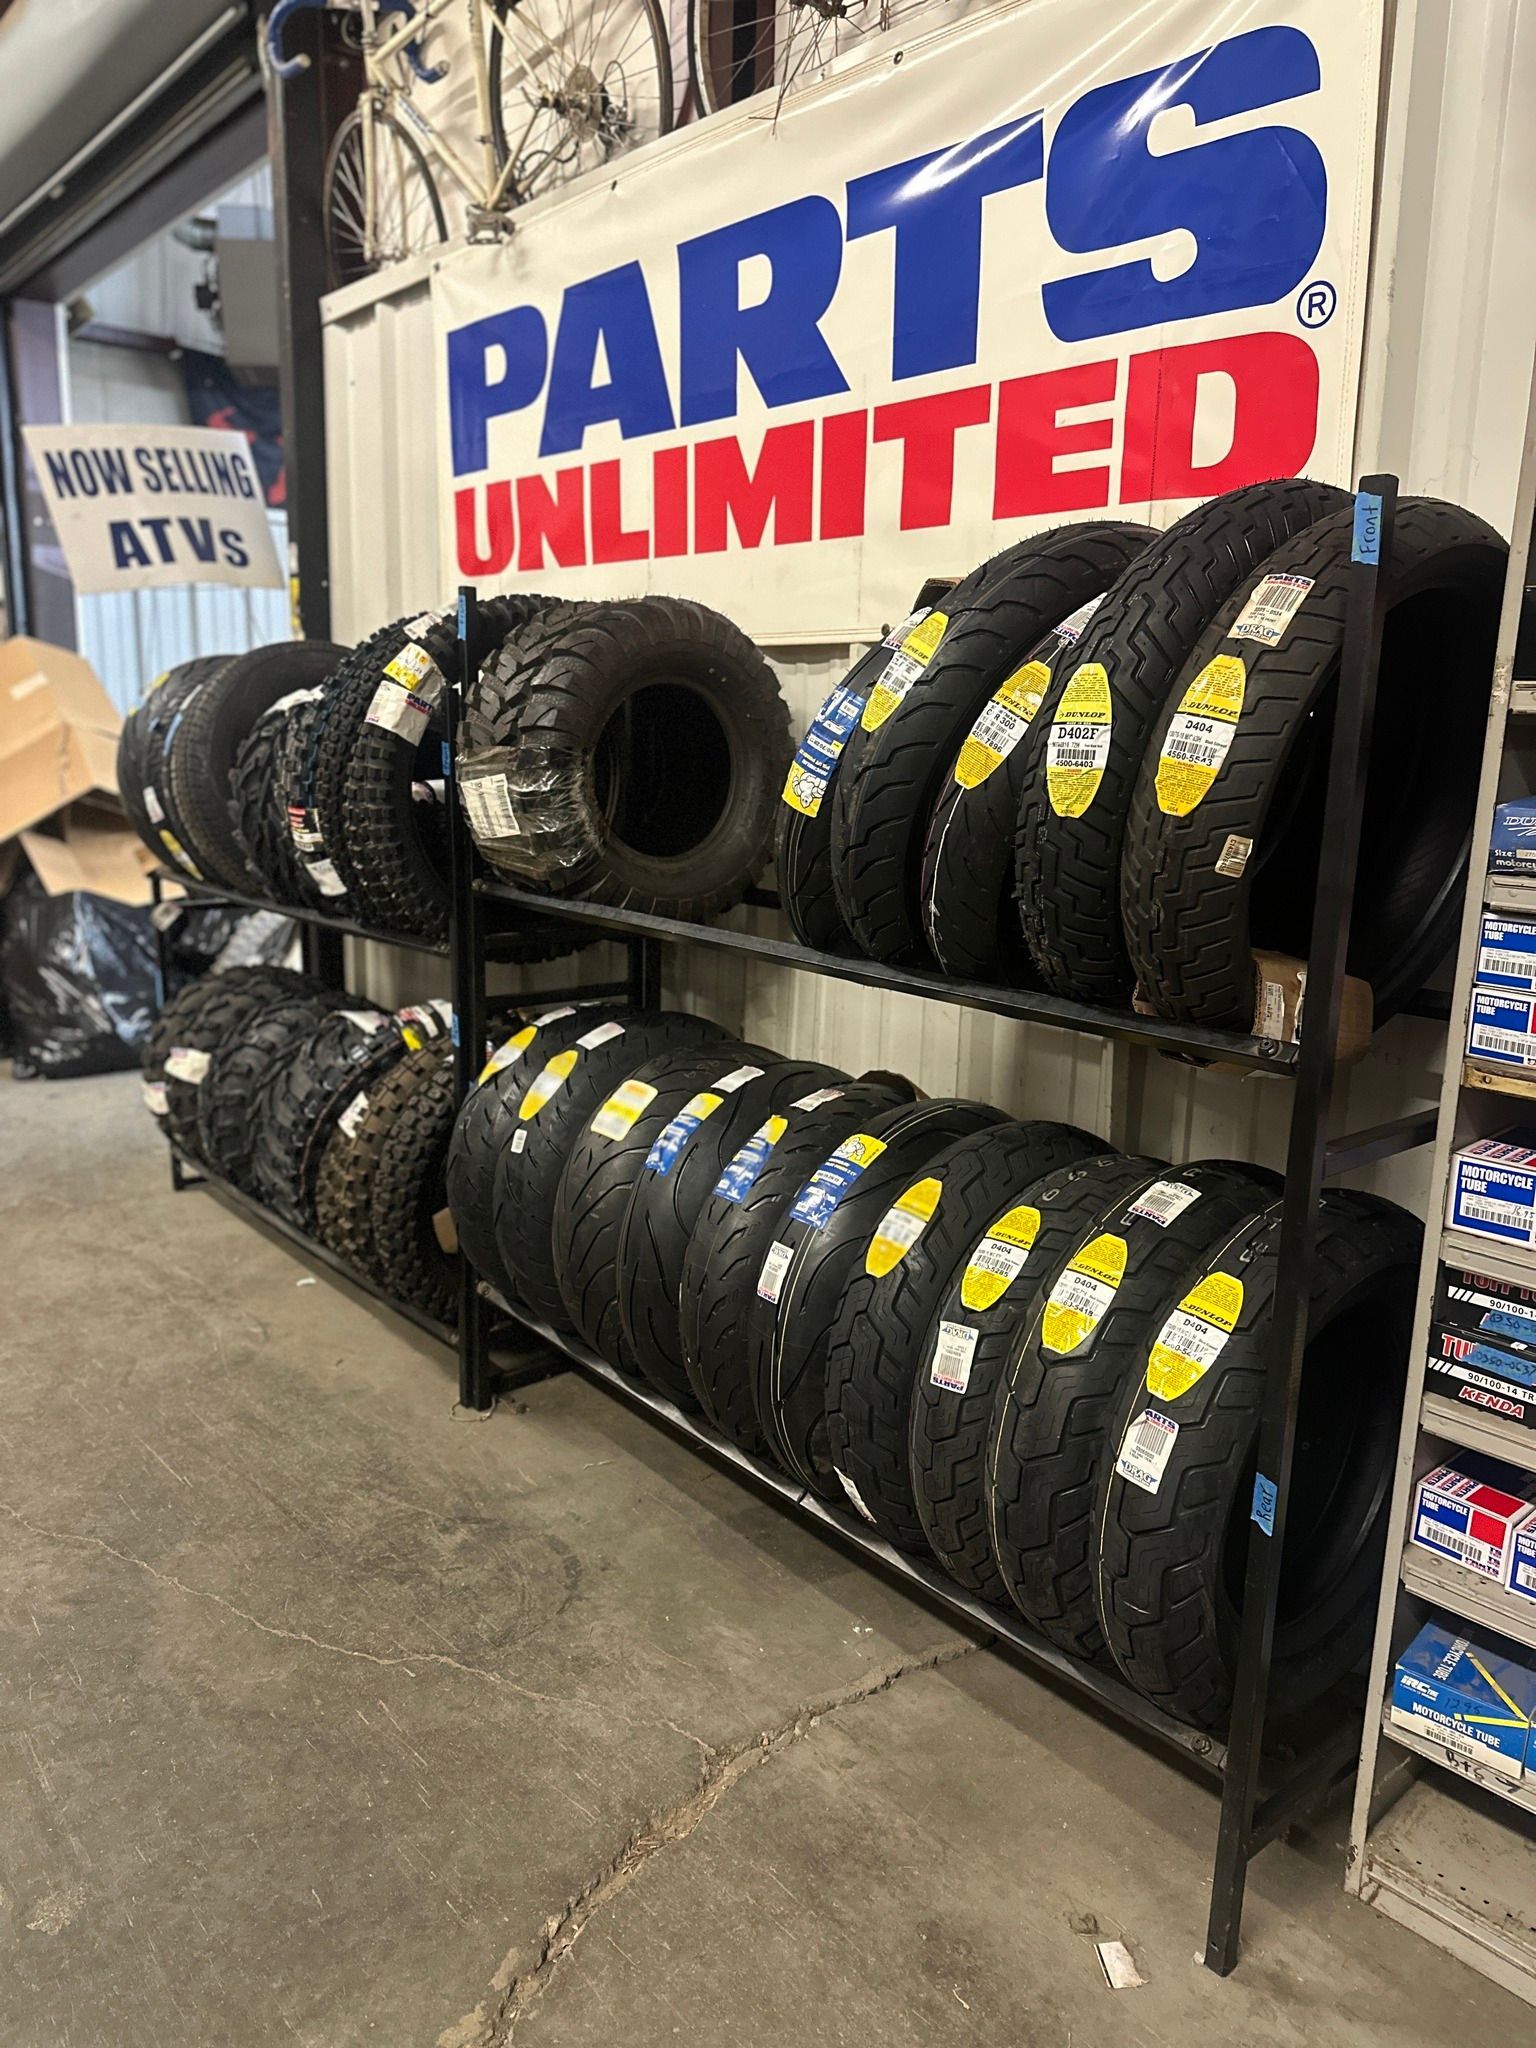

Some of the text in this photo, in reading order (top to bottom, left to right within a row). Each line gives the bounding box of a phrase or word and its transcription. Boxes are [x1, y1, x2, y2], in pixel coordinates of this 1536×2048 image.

[447, 25, 1328, 476] PARTS
[454, 331, 1319, 577] UNLIMITED
[44, 447, 257, 499] NOW SELLING
[1359, 505, 1379, 553] Front
[109, 518, 249, 568] ATVs
[1240, 624, 1274, 638] DRAG
[1064, 711, 1106, 719] DUNLOP
[1187, 701, 1239, 717] DUNLOP
[1057, 727, 1099, 740] D402F
[1185, 720, 1214, 734] D404
[1055, 759, 1094, 768] 4500-6403
[1484, 921, 1536, 935] MOTORCYCLE
[1484, 930, 1504, 941] TUBE
[1476, 995, 1529, 1013] MOTORCYCLE
[1476, 1004, 1496, 1016] TUBE
[1460, 1176, 1488, 1194] TUBE
[1461, 1164, 1534, 1191] MOTORCYCLE
[995, 1231, 1031, 1246] DUNLOP
[990, 1243, 1012, 1255] D404
[1077, 1263, 1120, 1283] DUNLOP
[1073, 1277, 1098, 1292] D404
[1187, 1304, 1233, 1327] DUNLOP
[1183, 1318, 1208, 1335] D404
[933, 1376, 964, 1391] PARTS
[1468, 1372, 1518, 1396] 90/100-14
[1459, 1386, 1525, 1419] KENDA
[1145, 1410, 1176, 1430] ARTS
[1124, 1460, 1152, 1483] DRAG
[1255, 1482, 1274, 1522] Rear
[1421, 1498, 1440, 1512] TUBE
[1422, 1490, 1469, 1516] MOTORCYCLE
[1517, 1545, 1536, 1558] TUBE
[1400, 1675, 1430, 1694] IRC
[1412, 1702, 1474, 1737] MOTORCYCLE
[1475, 1728, 1501, 1748] TUBE
